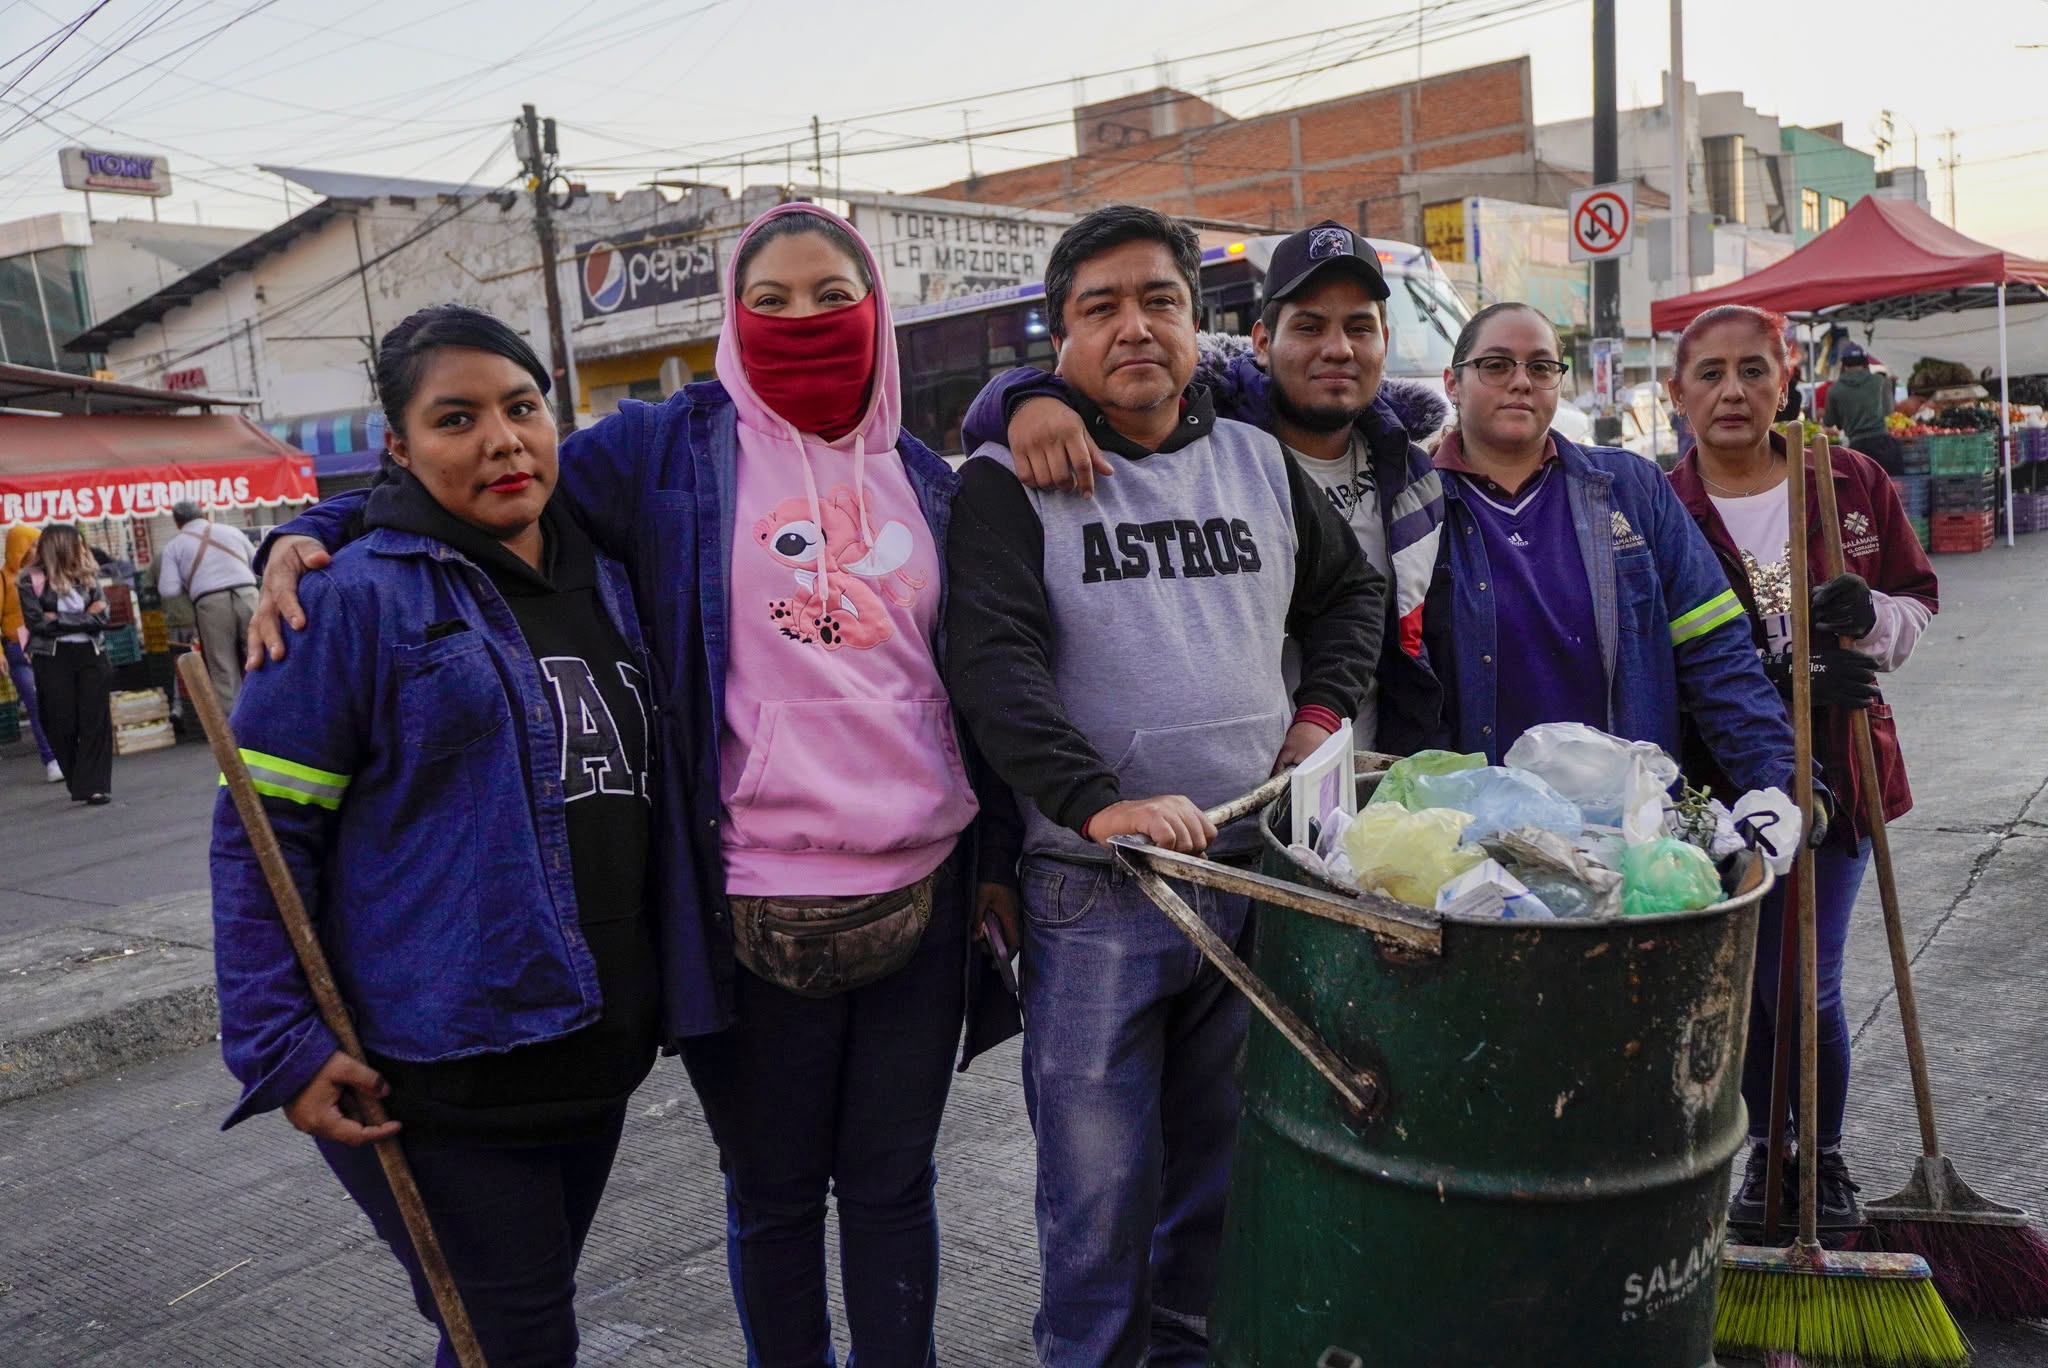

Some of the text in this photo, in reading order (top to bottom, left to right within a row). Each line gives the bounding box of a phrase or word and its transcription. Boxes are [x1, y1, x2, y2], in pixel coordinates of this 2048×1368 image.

[891, 212, 1046, 248] TORTILLERIA
[893, 243, 1034, 275] LA MAZORCA
[0, 476, 249, 520] RUTAS Y VERDURAS
[1082, 517, 1262, 584] ASTROS
[1841, 535, 1879, 549] SALAMANC
